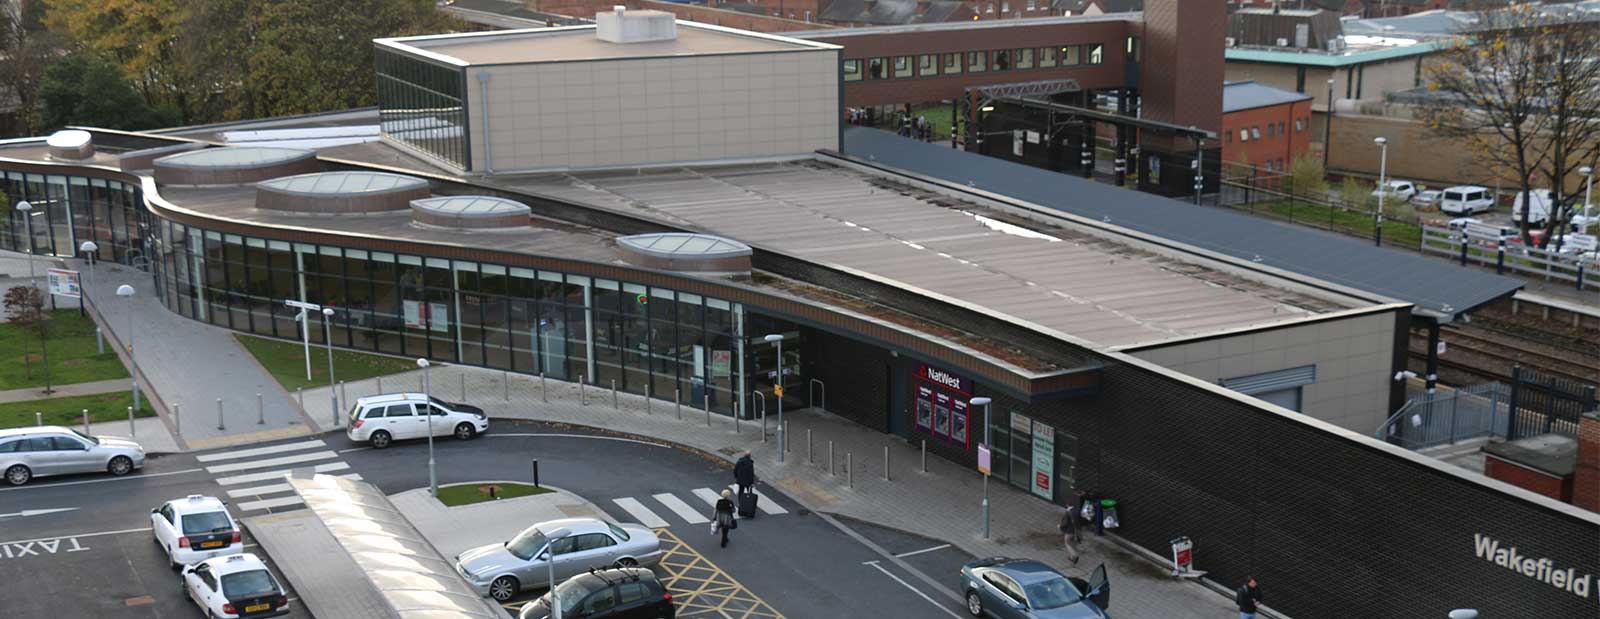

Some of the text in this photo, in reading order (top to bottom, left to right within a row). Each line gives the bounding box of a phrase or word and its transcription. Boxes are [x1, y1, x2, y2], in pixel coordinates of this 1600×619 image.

[928, 367, 960, 389] NatWest
[0, 537, 90, 558] TAXI
[1474, 533, 1591, 598] Wakefield
